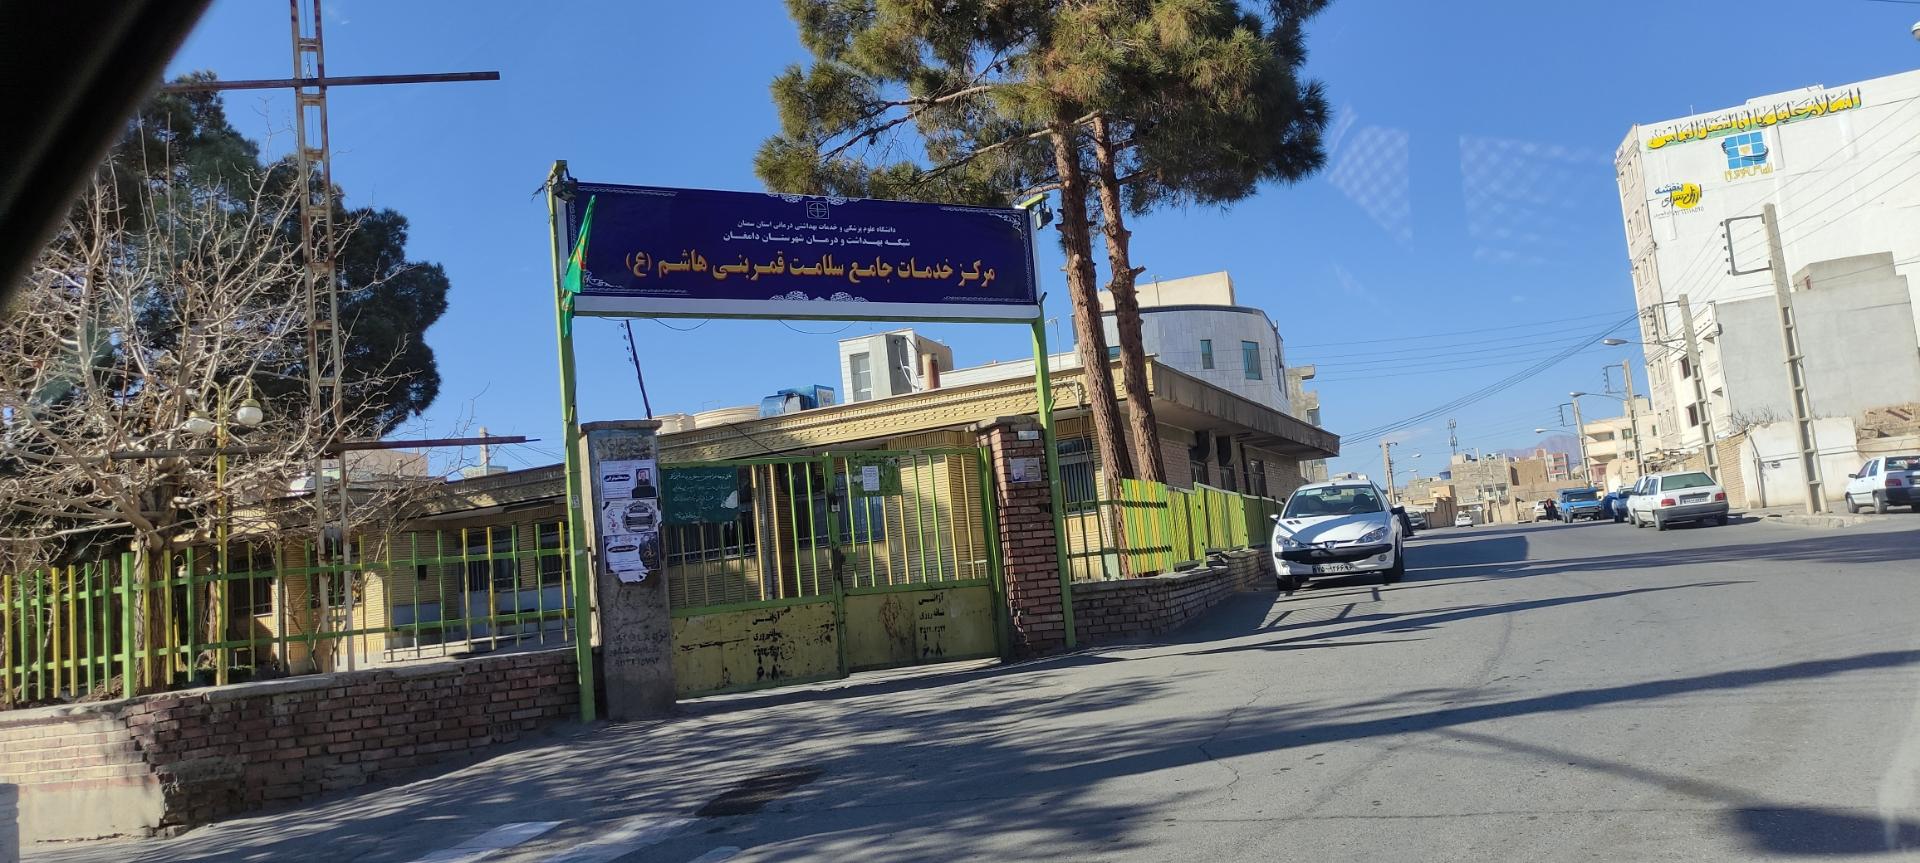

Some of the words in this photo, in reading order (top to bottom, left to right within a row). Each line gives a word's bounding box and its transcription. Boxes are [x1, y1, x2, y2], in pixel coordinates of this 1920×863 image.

[773, 220, 794, 230] درمانی
[794, 221, 818, 231] بهداشتی
[818, 222, 838, 231] خدمات
[843, 224, 863, 234] پزشکی
[862, 224, 875, 234] علوم
[876, 225, 896, 233] دانشگاه
[723, 230, 760, 242] دامغان
[761, 232, 805, 246] شهرستان
[805, 234, 839, 246] درمان
[846, 235, 883, 247] بهداشت
[884, 237, 911, 247] شبکه
[625, 250, 653, 279] (ع)
[658, 248, 708, 279] هاشم
[789, 253, 845, 277] سلامت
[848, 255, 893, 284] جامع
[897, 255, 954, 280] خدمات
[957, 258, 996, 287] مرکز
